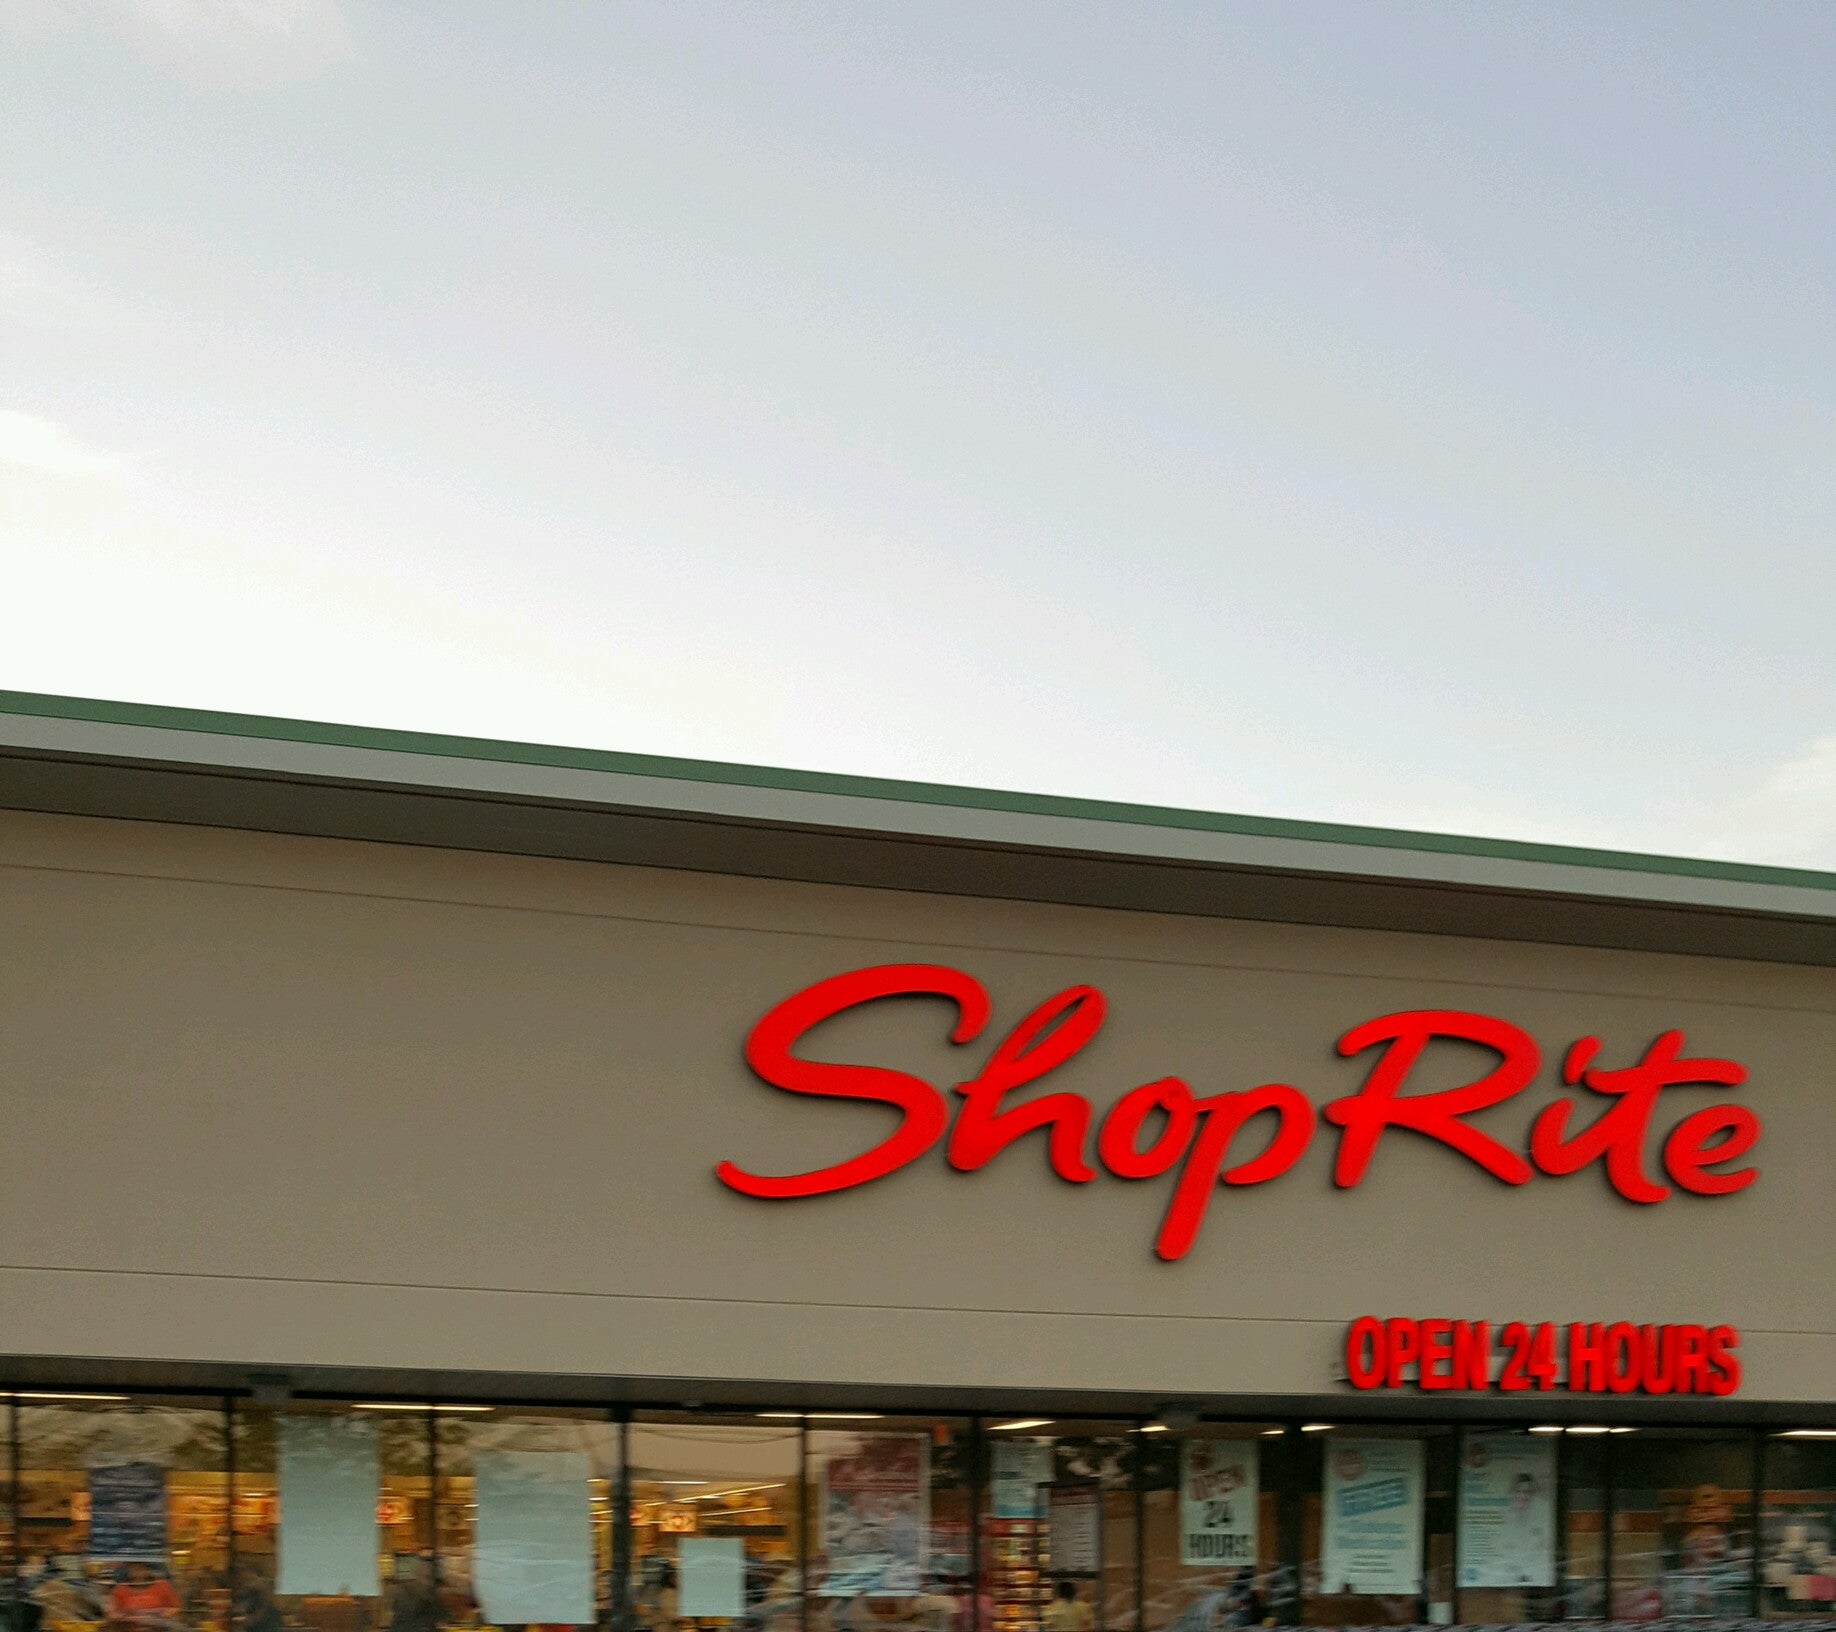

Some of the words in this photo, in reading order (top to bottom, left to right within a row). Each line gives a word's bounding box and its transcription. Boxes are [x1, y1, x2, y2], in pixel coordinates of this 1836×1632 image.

[715, 964, 1762, 1261] ShopRite
[1346, 1315, 1491, 1391] OPEN
[1499, 1321, 1560, 1391] 24
[1568, 1321, 1743, 1397] HOURS
[1203, 1500, 1233, 1528] 24
[1187, 1533, 1253, 1558] HOURS
